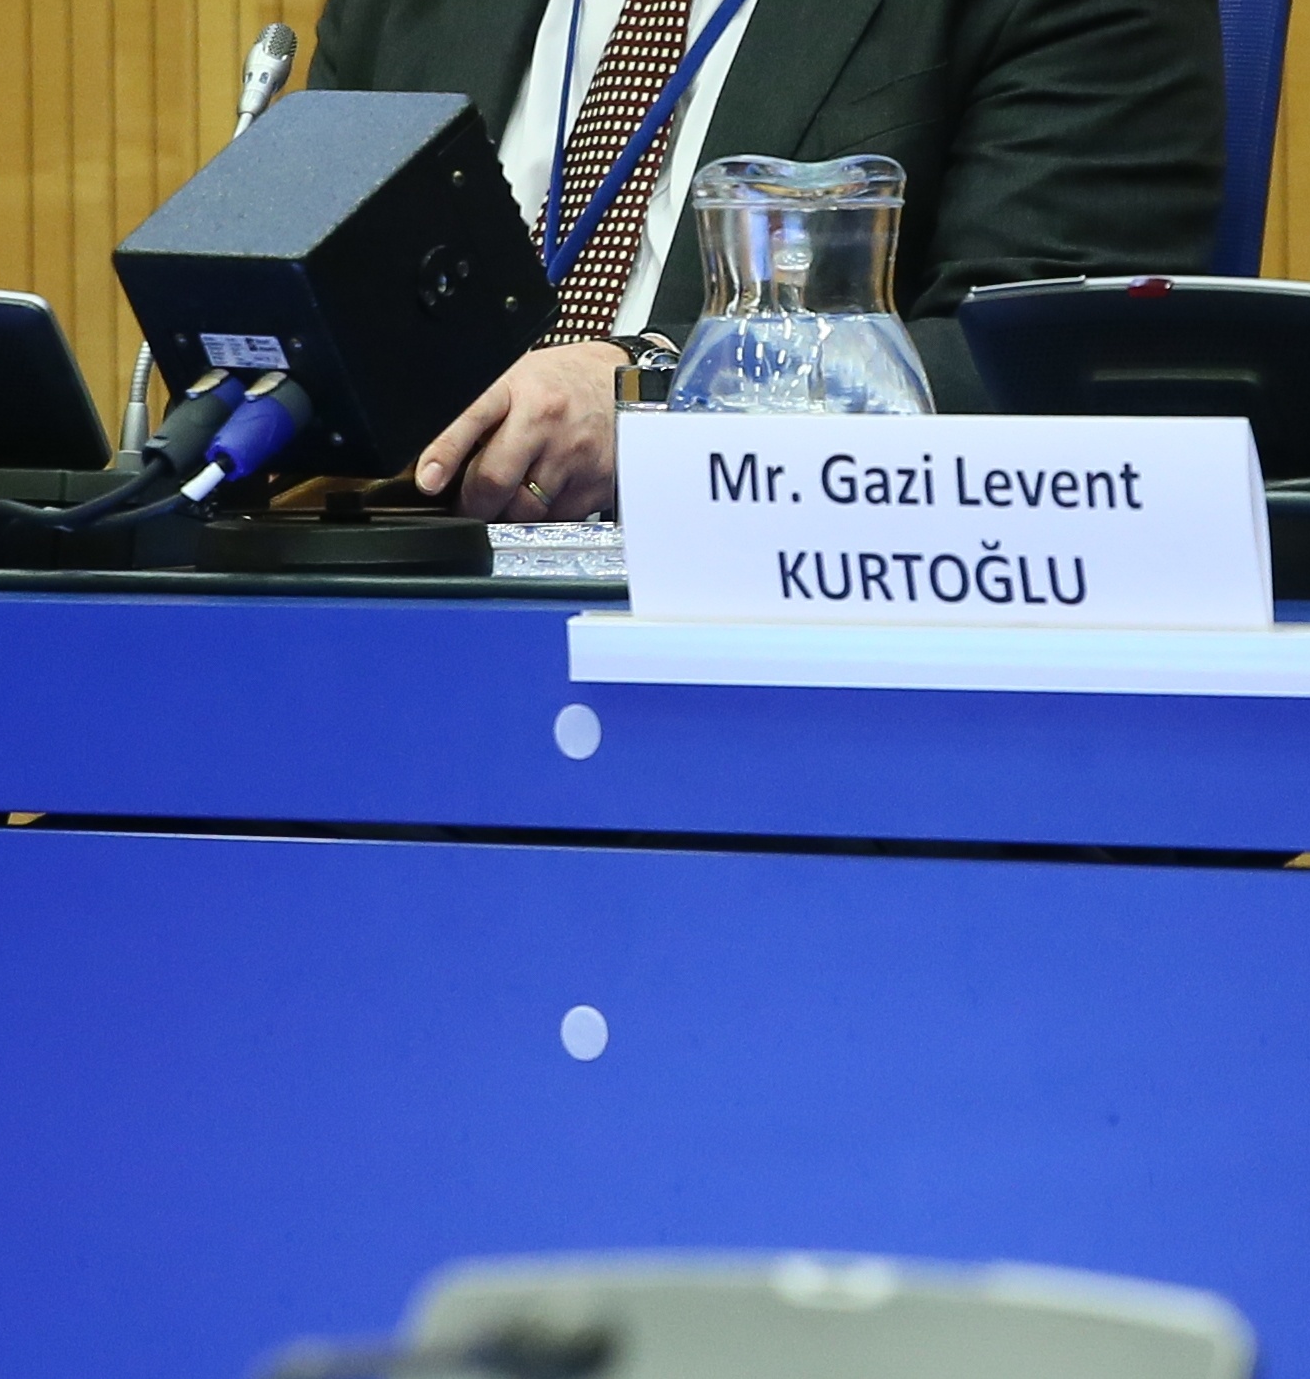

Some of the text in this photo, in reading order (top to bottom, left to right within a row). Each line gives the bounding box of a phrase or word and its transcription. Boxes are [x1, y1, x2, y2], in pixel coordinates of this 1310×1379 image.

[709, 452, 1143, 510] Mr. Gazi Levent
[777, 539, 1087, 606] KURTOĞLU
